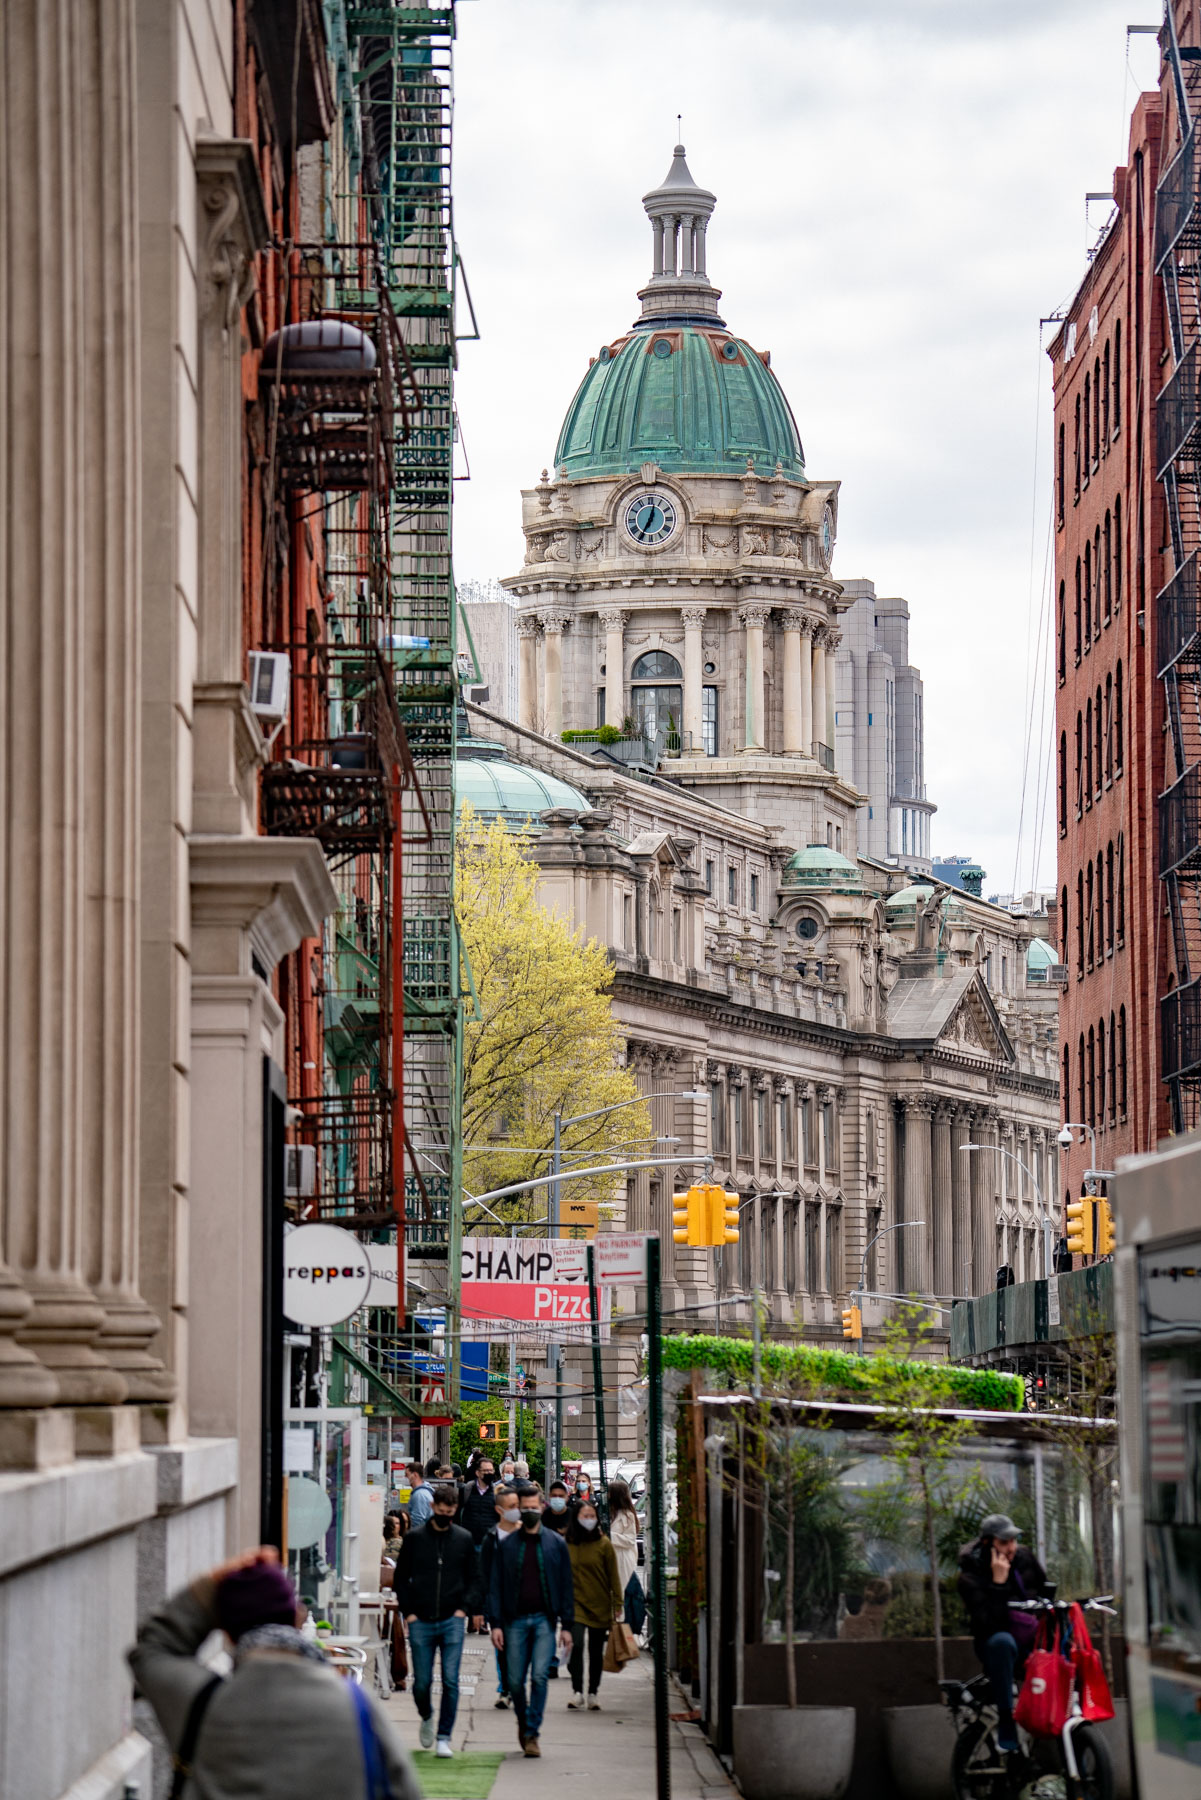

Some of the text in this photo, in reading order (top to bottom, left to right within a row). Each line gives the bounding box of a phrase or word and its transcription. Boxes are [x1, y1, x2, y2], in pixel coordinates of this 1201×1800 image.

[599, 1239, 643, 1249] NO PARKING
[563, 1248, 585, 1256] PARKING
[556, 1257, 576, 1265] Anytime
[599, 1252, 630, 1263] Anytime
[461, 1250, 589, 1282] CHAMP
[287, 1266, 366, 1284] reppas
[499, 1321, 519, 1330] NEW
